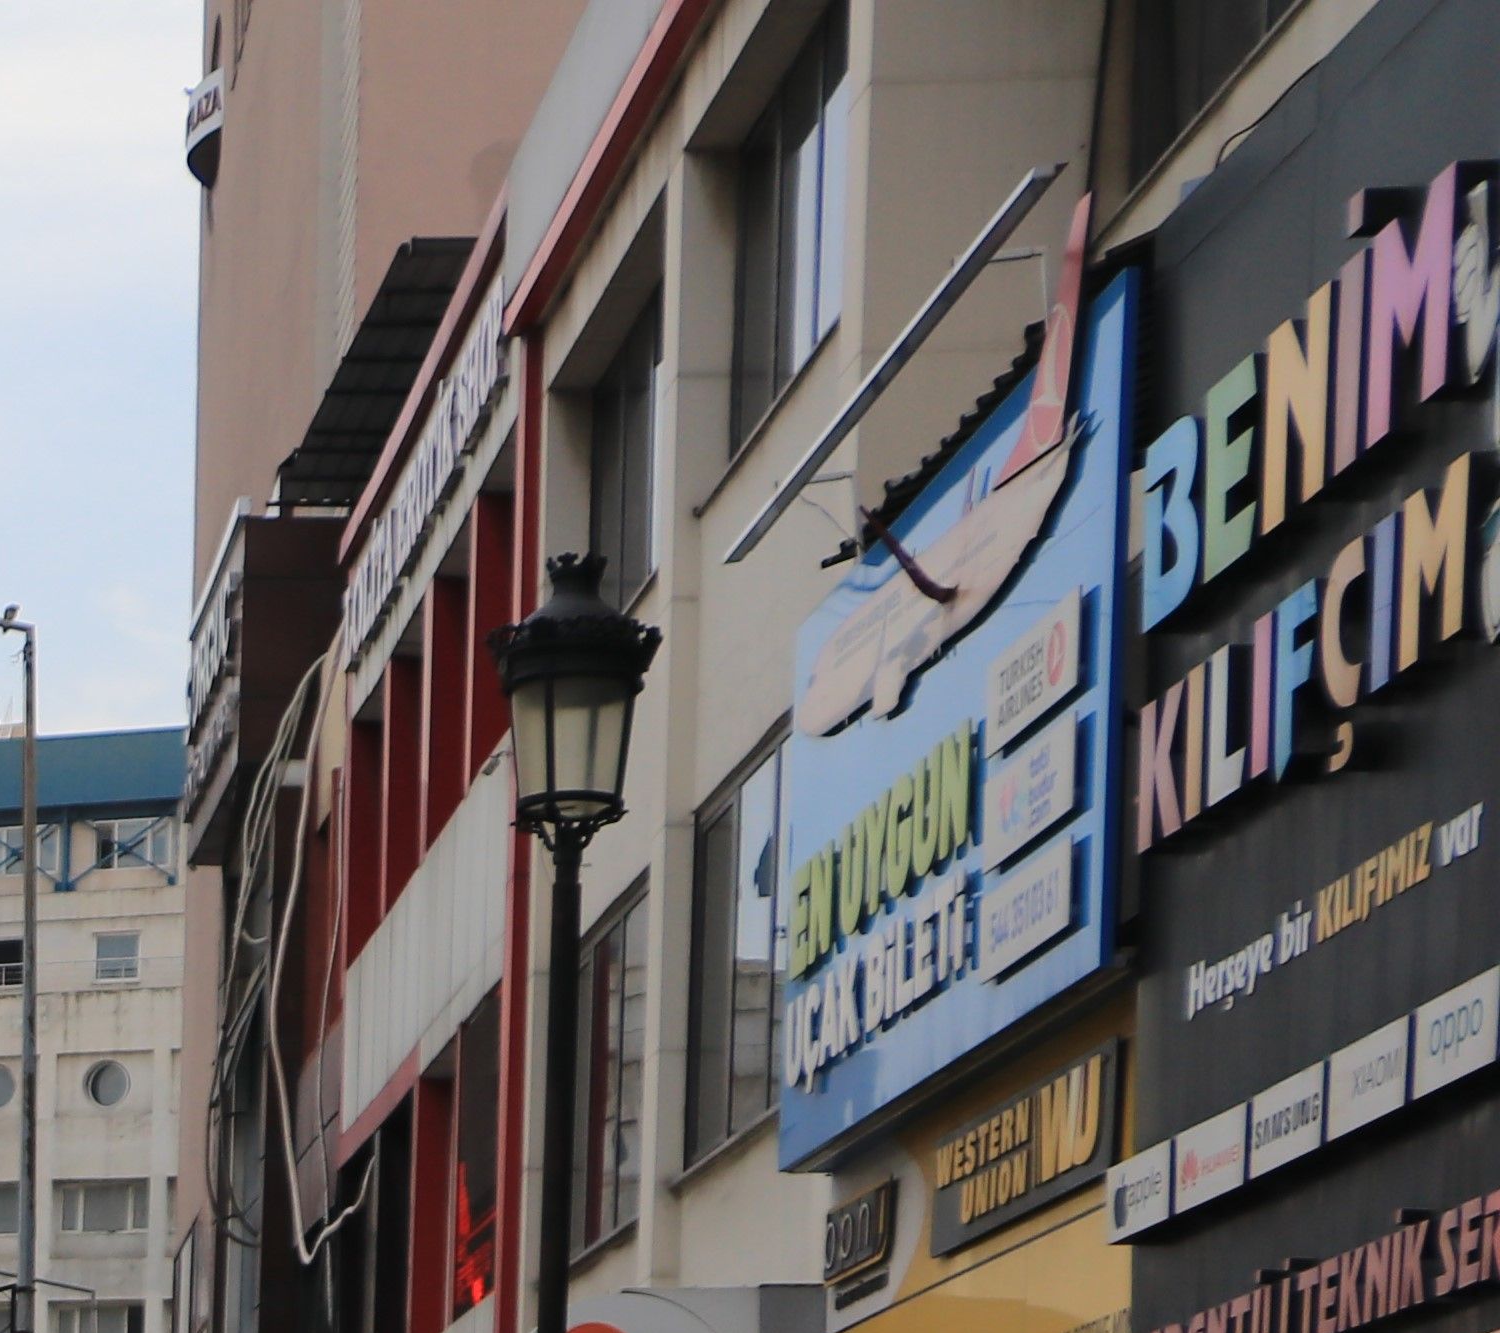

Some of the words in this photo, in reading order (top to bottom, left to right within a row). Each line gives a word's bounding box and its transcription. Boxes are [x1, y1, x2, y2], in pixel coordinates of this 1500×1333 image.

[997, 669, 1045, 729] AIRLINES
[998, 638, 1045, 692] TURKISH
[790, 838, 835, 982] EN
[838, 717, 973, 937] UYGUN
[1186, 932, 1274, 1022] Herşeye
[1275, 899, 1313, 966] bir
[1315, 820, 1435, 945] KILIFIMIZ
[1436, 800, 1485, 868] var
[785, 953, 863, 1096] UÇAK
[864, 870, 968, 1034] BİLETİ
[1428, 997, 1485, 1064] oppo
[936, 1097, 1032, 1189] WESTERN
[1254, 1091, 1321, 1151] SAMSUNG
[959, 1150, 1029, 1225] UNION
